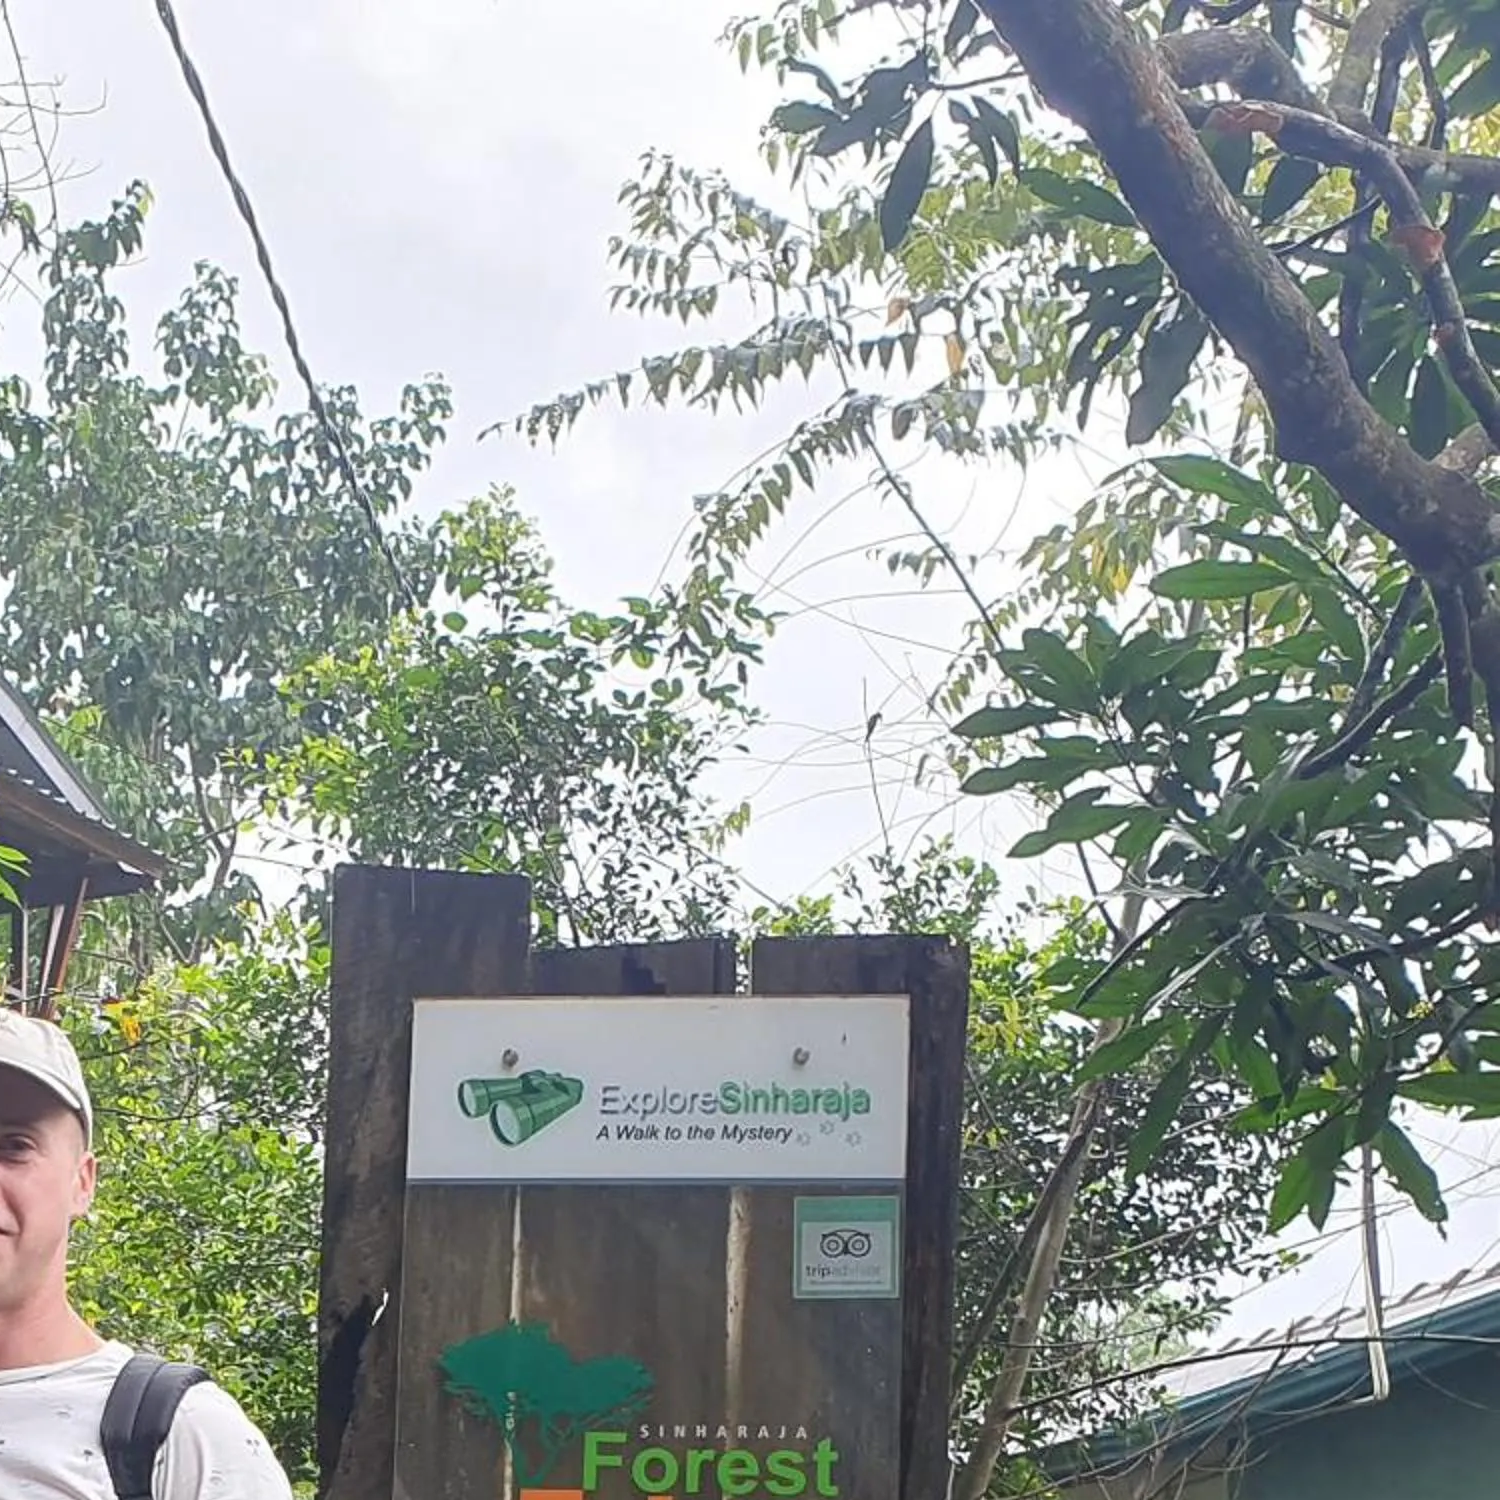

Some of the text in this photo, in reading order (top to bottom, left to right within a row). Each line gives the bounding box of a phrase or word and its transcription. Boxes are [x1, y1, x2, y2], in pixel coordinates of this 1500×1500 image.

[599, 1081, 872, 1121] ExploreSinharaja
[596, 1124, 793, 1144] A Walk to the Mystery
[640, 1423, 809, 1440] SINHARAJA
[582, 1431, 839, 1496] Forest
